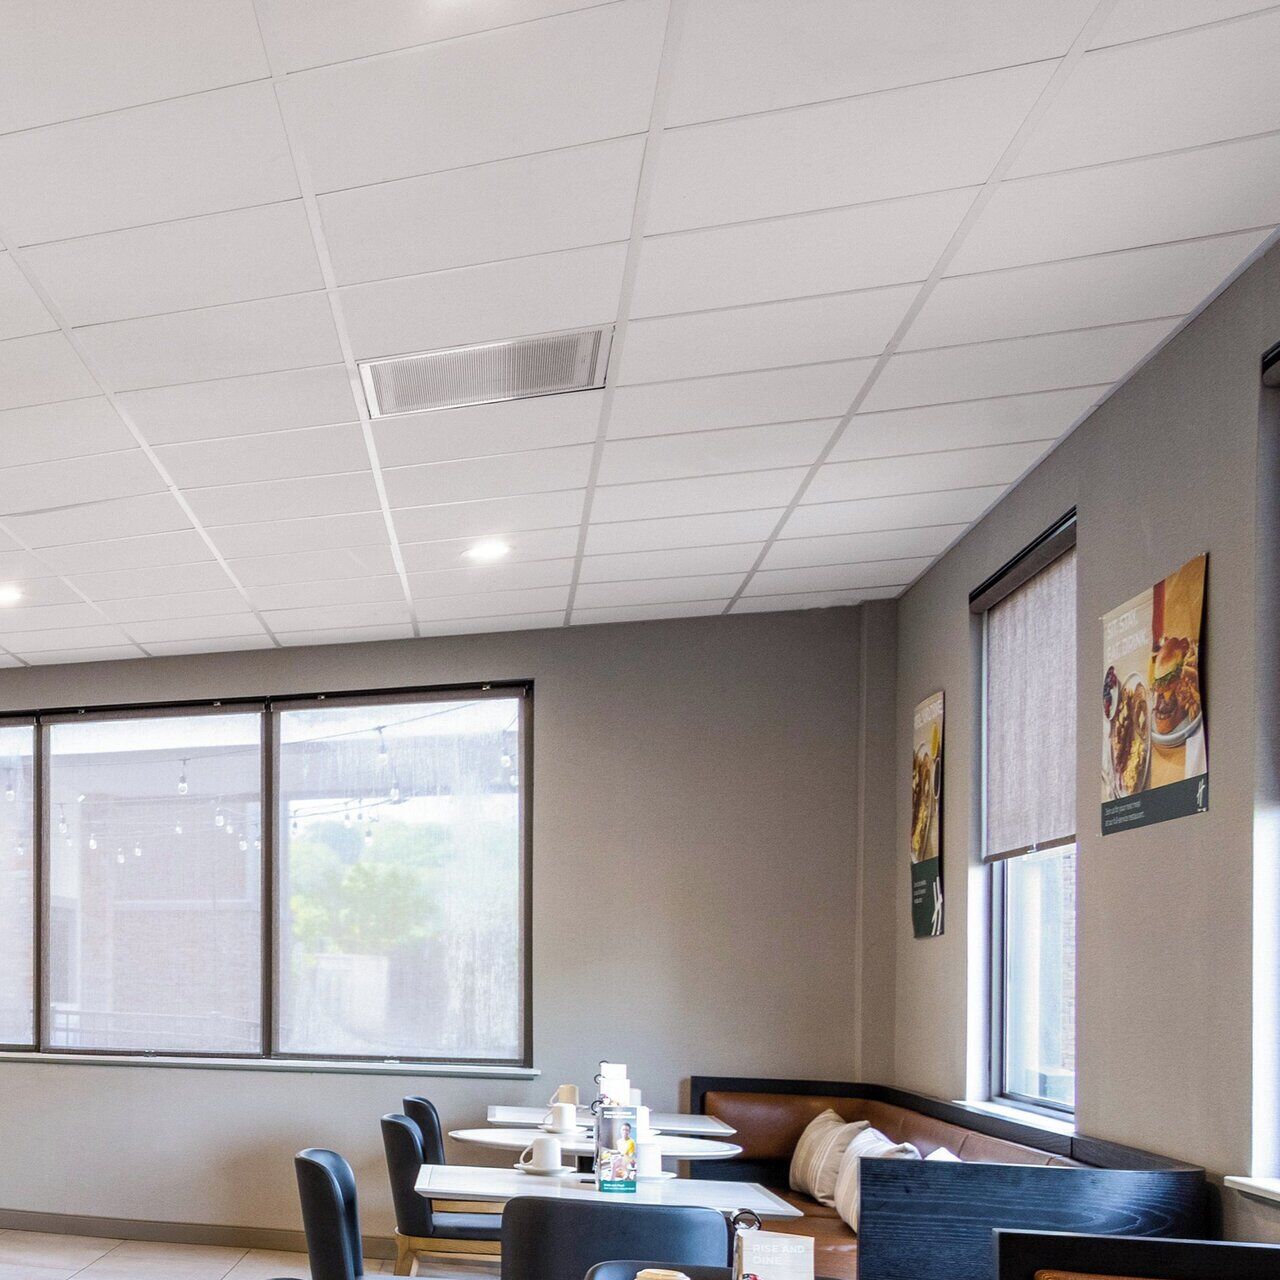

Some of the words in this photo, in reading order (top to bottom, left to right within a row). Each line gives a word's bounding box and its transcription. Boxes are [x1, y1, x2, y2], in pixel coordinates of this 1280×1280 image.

[752, 1244, 779, 1253] RISE
[782, 1244, 805, 1253] AND
[752, 1256, 783, 1265] DINE
